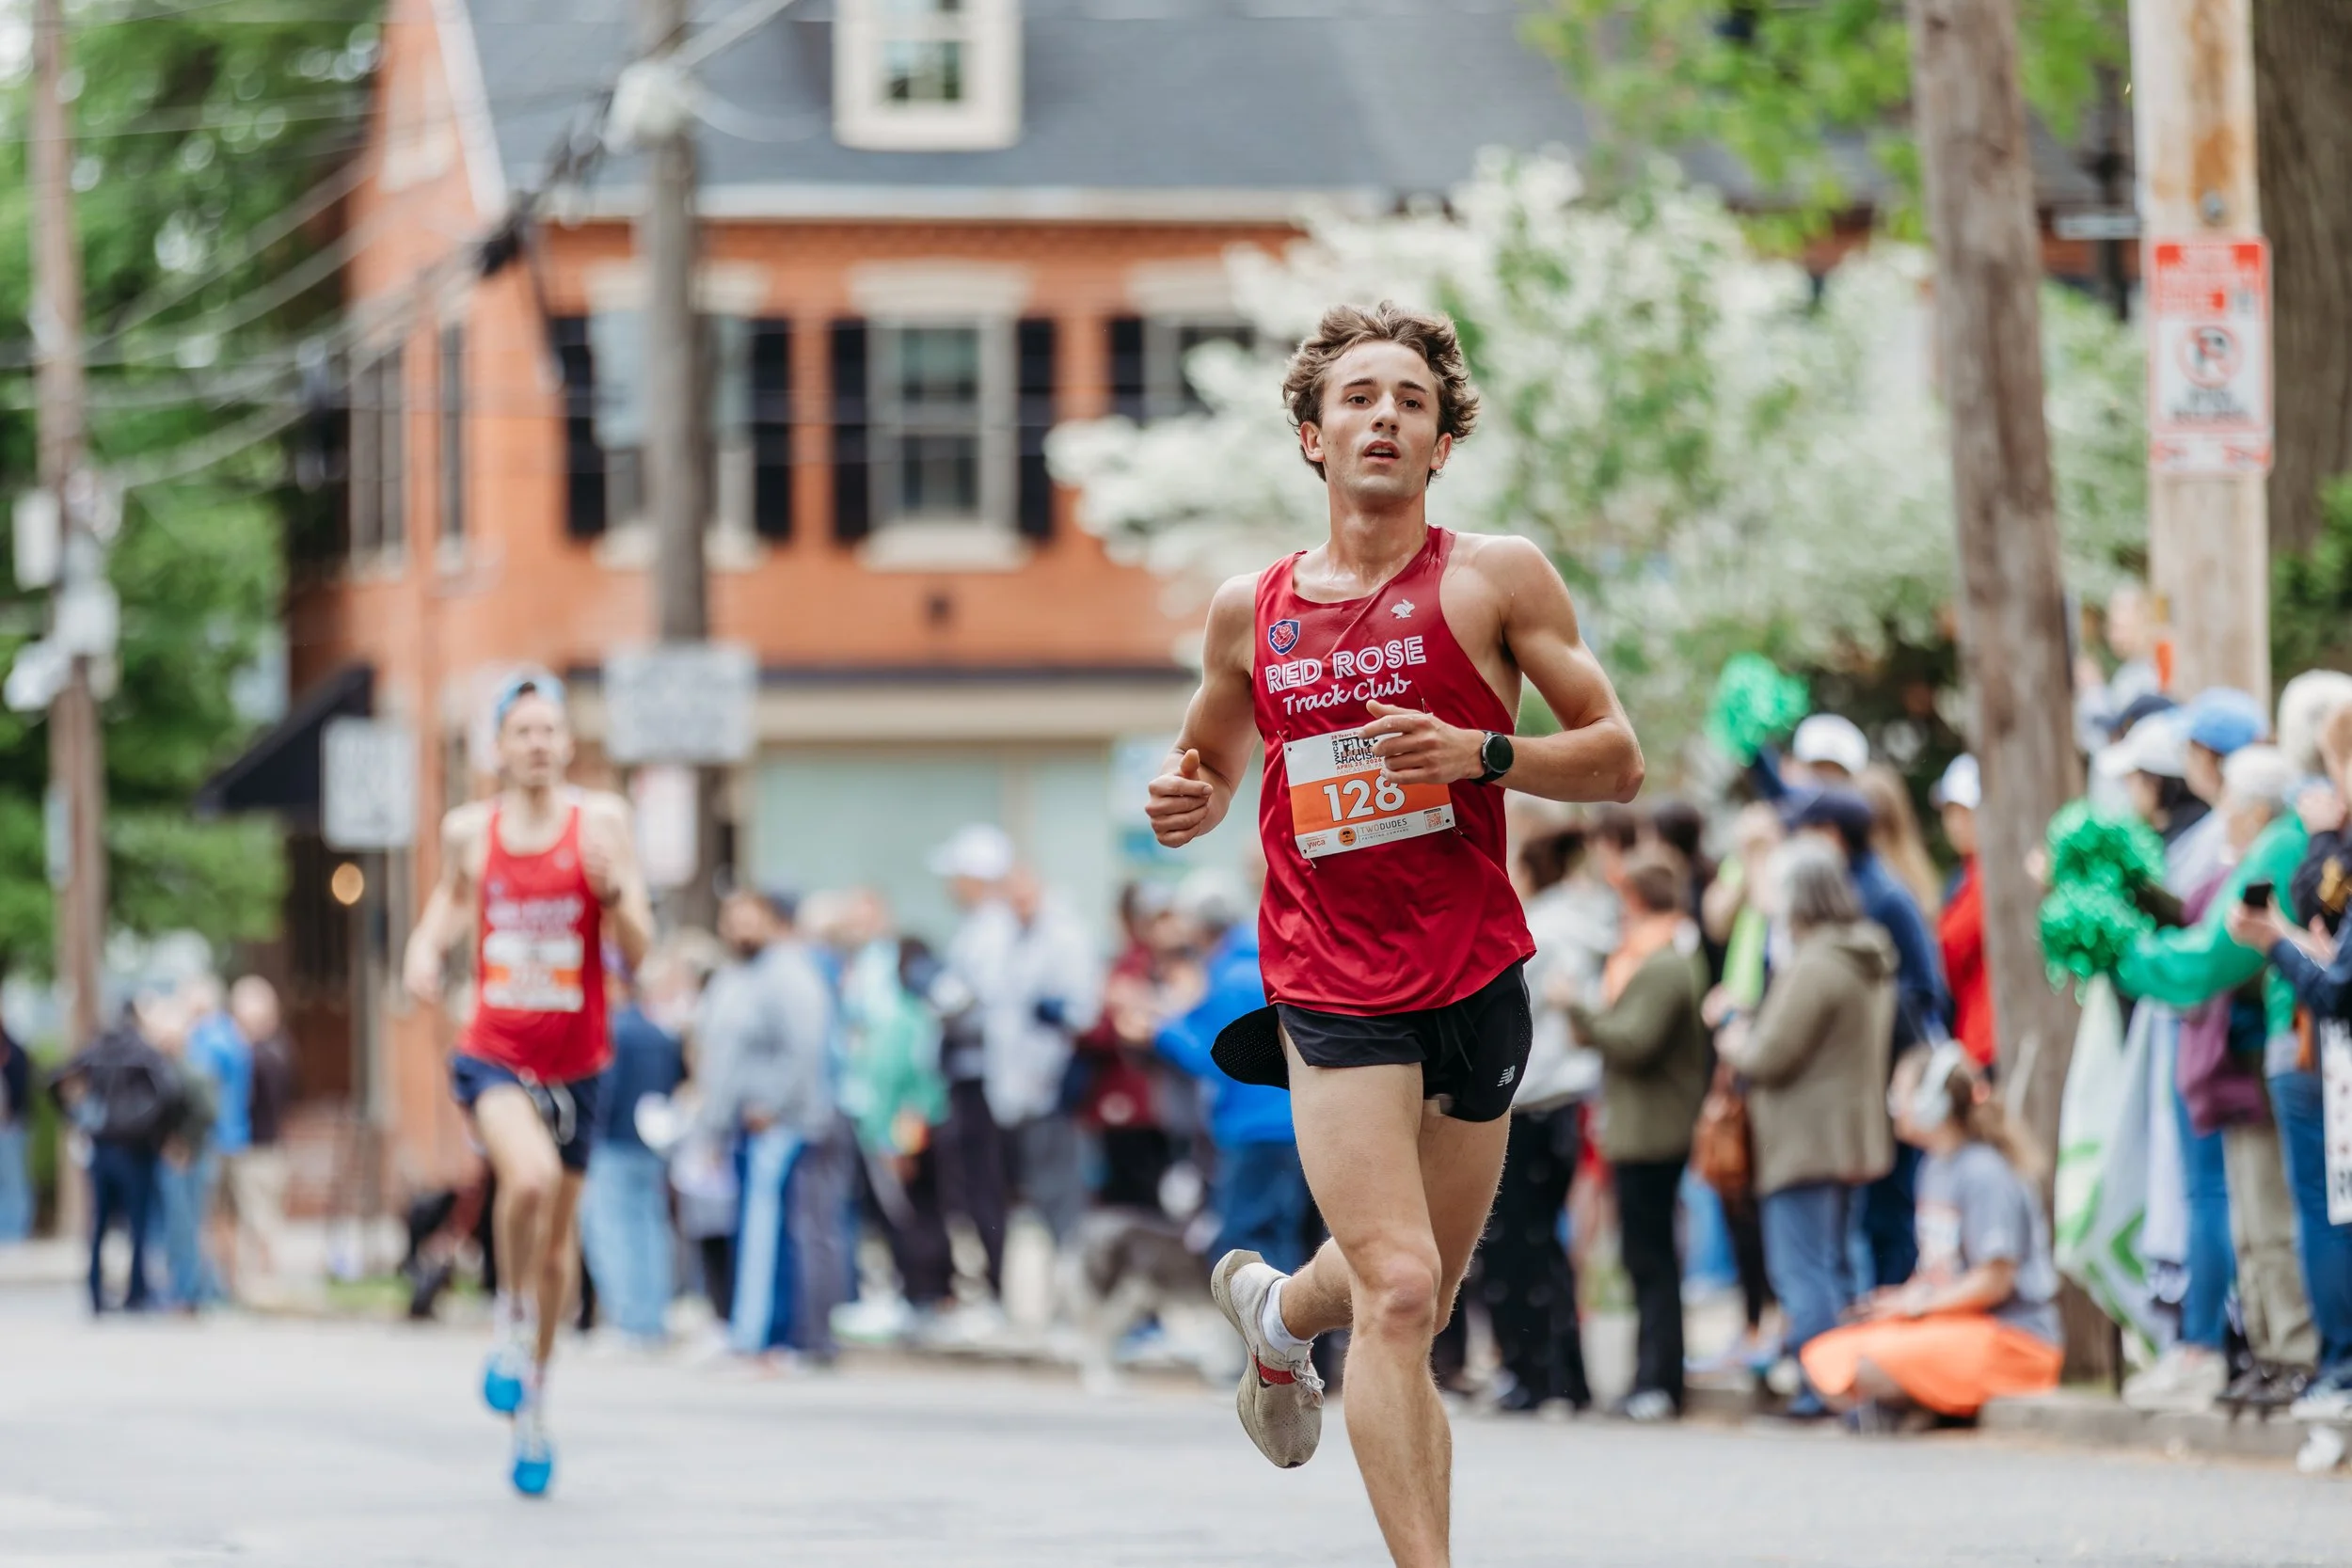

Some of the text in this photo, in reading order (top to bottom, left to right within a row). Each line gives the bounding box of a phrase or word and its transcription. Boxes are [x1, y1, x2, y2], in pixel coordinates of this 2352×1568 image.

[1264, 635, 1427, 694] RED ROSE
[1282, 672, 1412, 716] Track Club
[1323, 774, 1406, 822] 128
[1307, 840, 1326, 849] ywca
